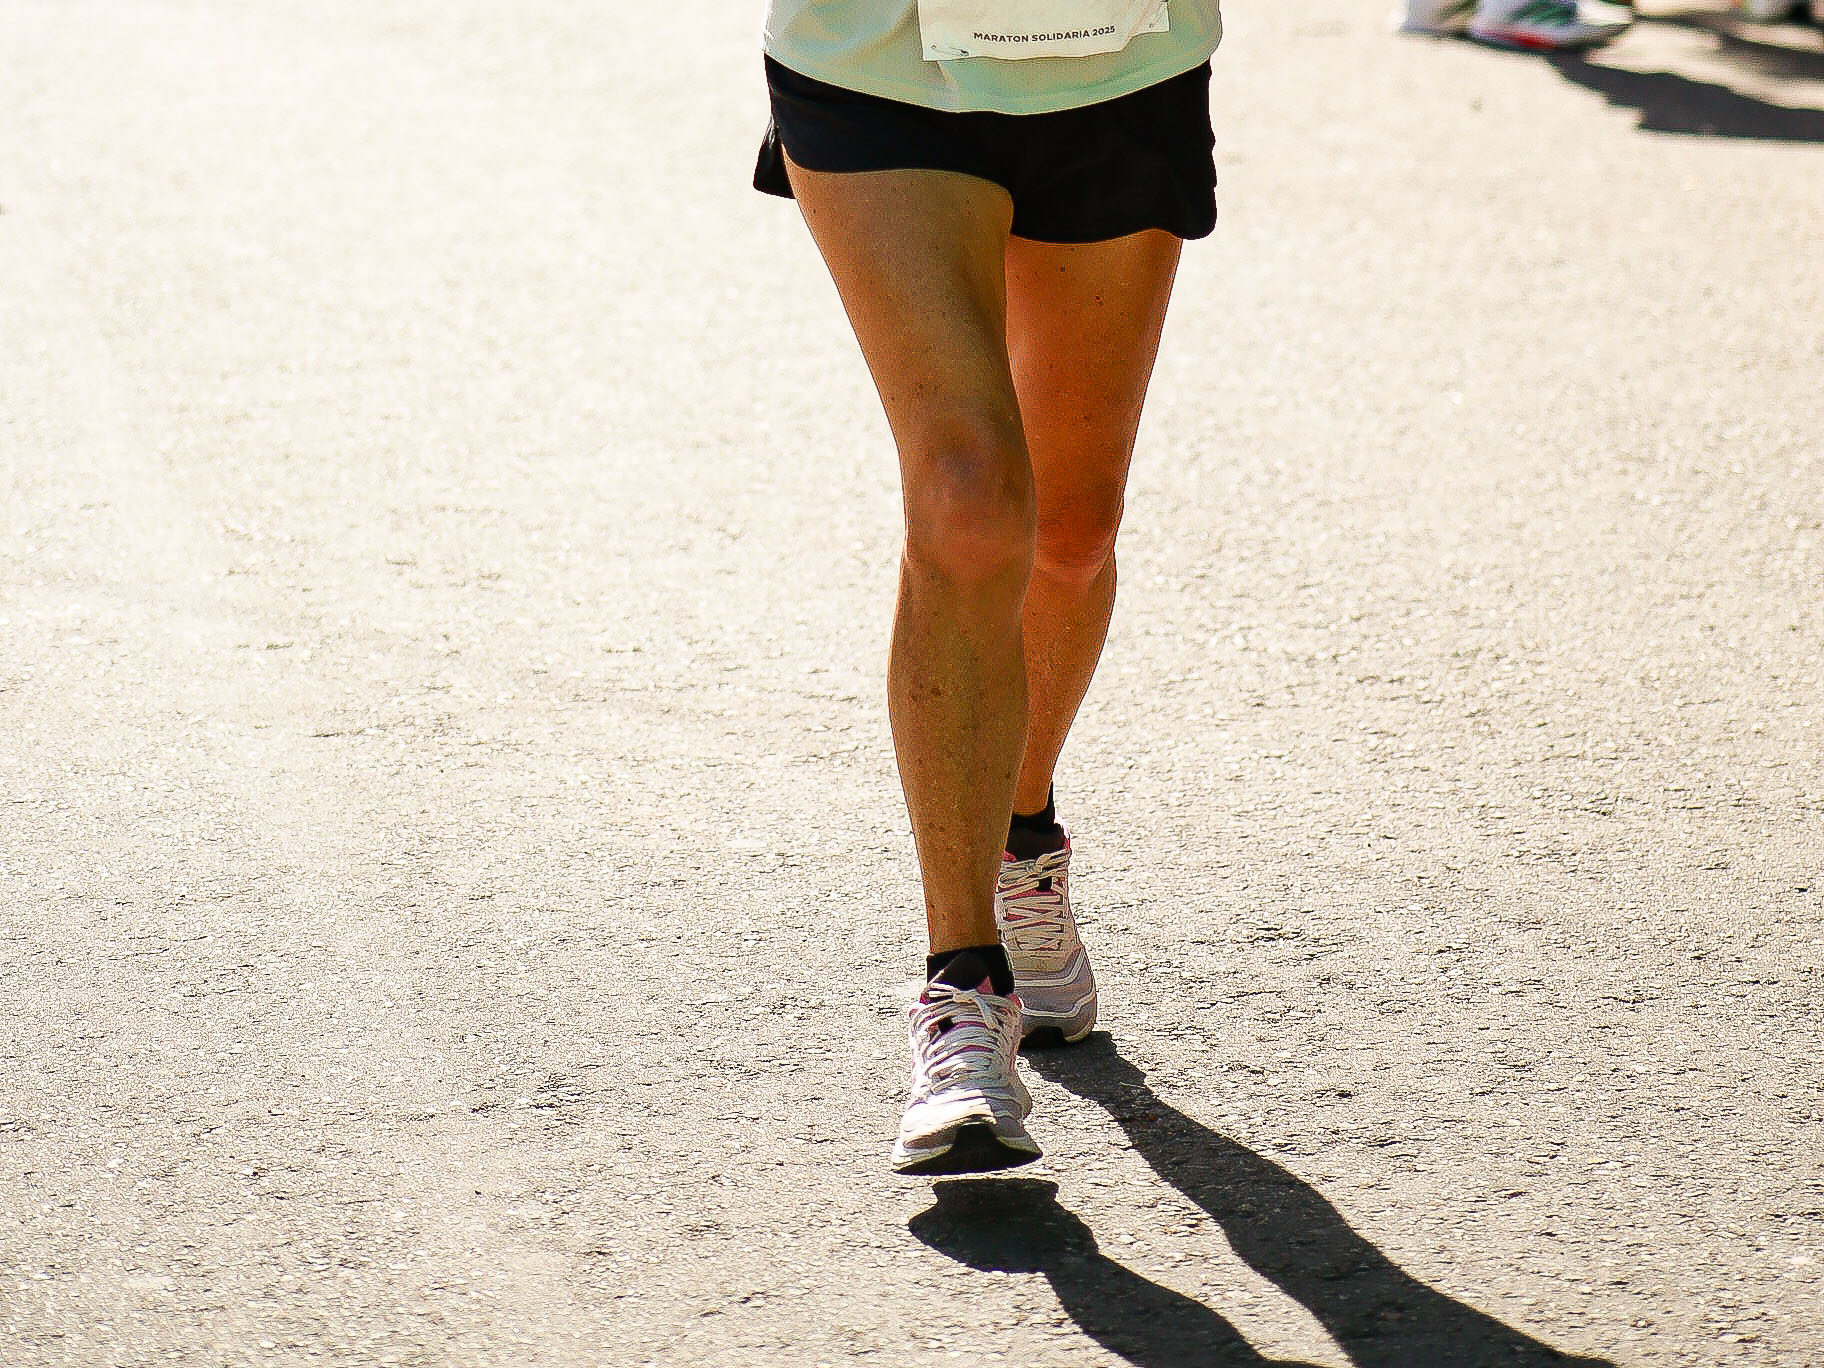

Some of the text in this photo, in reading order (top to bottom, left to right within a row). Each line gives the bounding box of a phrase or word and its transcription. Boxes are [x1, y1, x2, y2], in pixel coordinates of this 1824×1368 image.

[973, 25, 1116, 42] MARATON SOLIDARIA 2025
